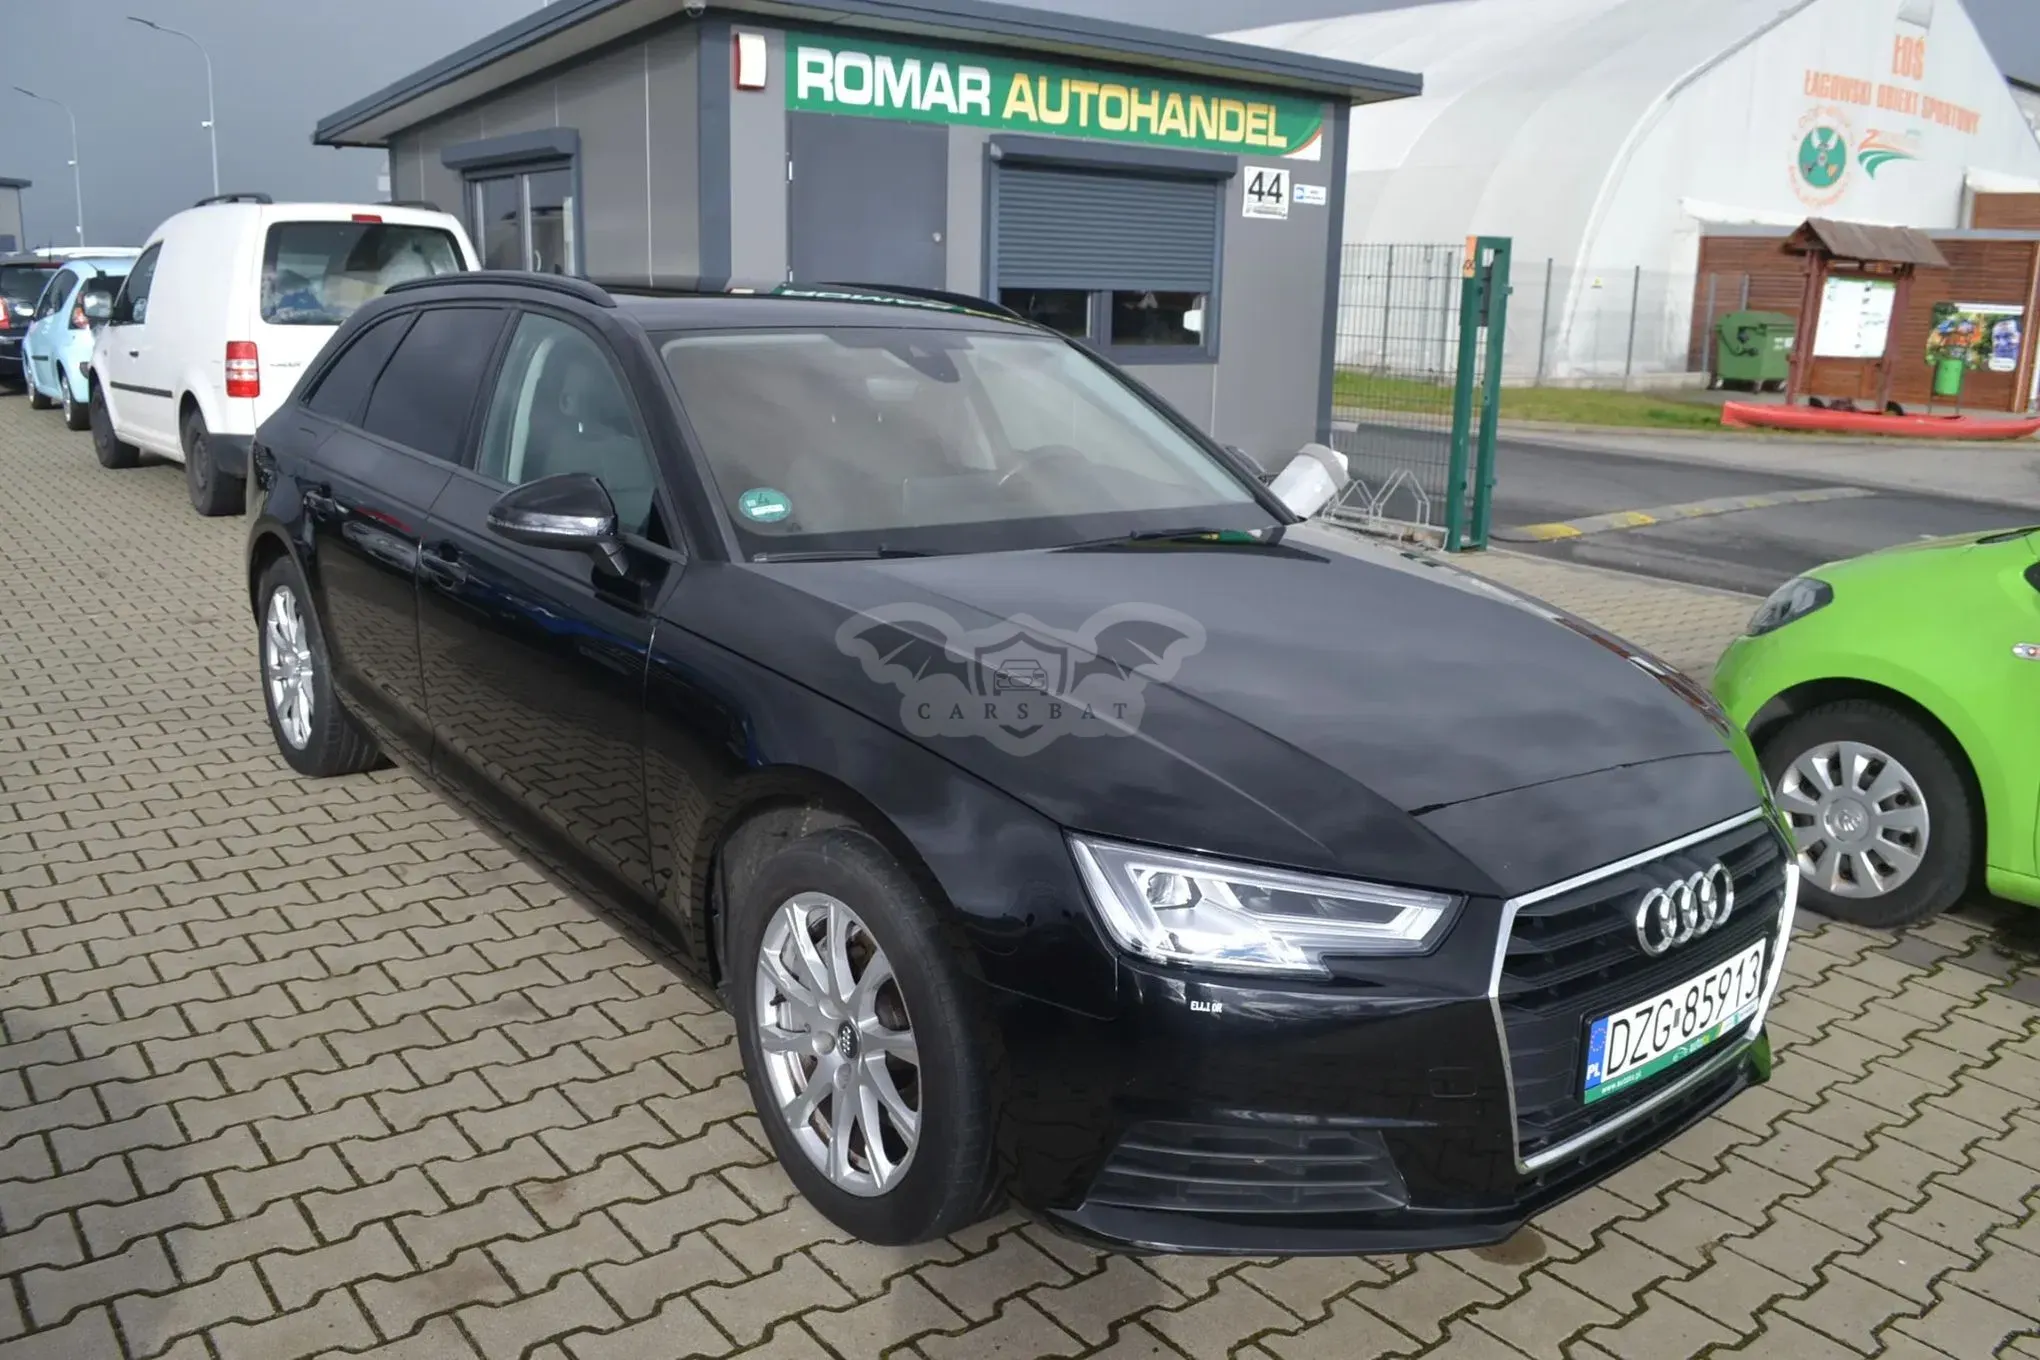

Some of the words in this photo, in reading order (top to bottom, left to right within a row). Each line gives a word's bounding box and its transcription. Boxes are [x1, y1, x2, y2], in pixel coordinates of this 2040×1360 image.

[797, 46, 992, 117] ROMAR
[1002, 72, 1289, 149] AUTOHANDEL
[1248, 170, 1283, 204] 44
[1586, 1062, 1601, 1081] PL
